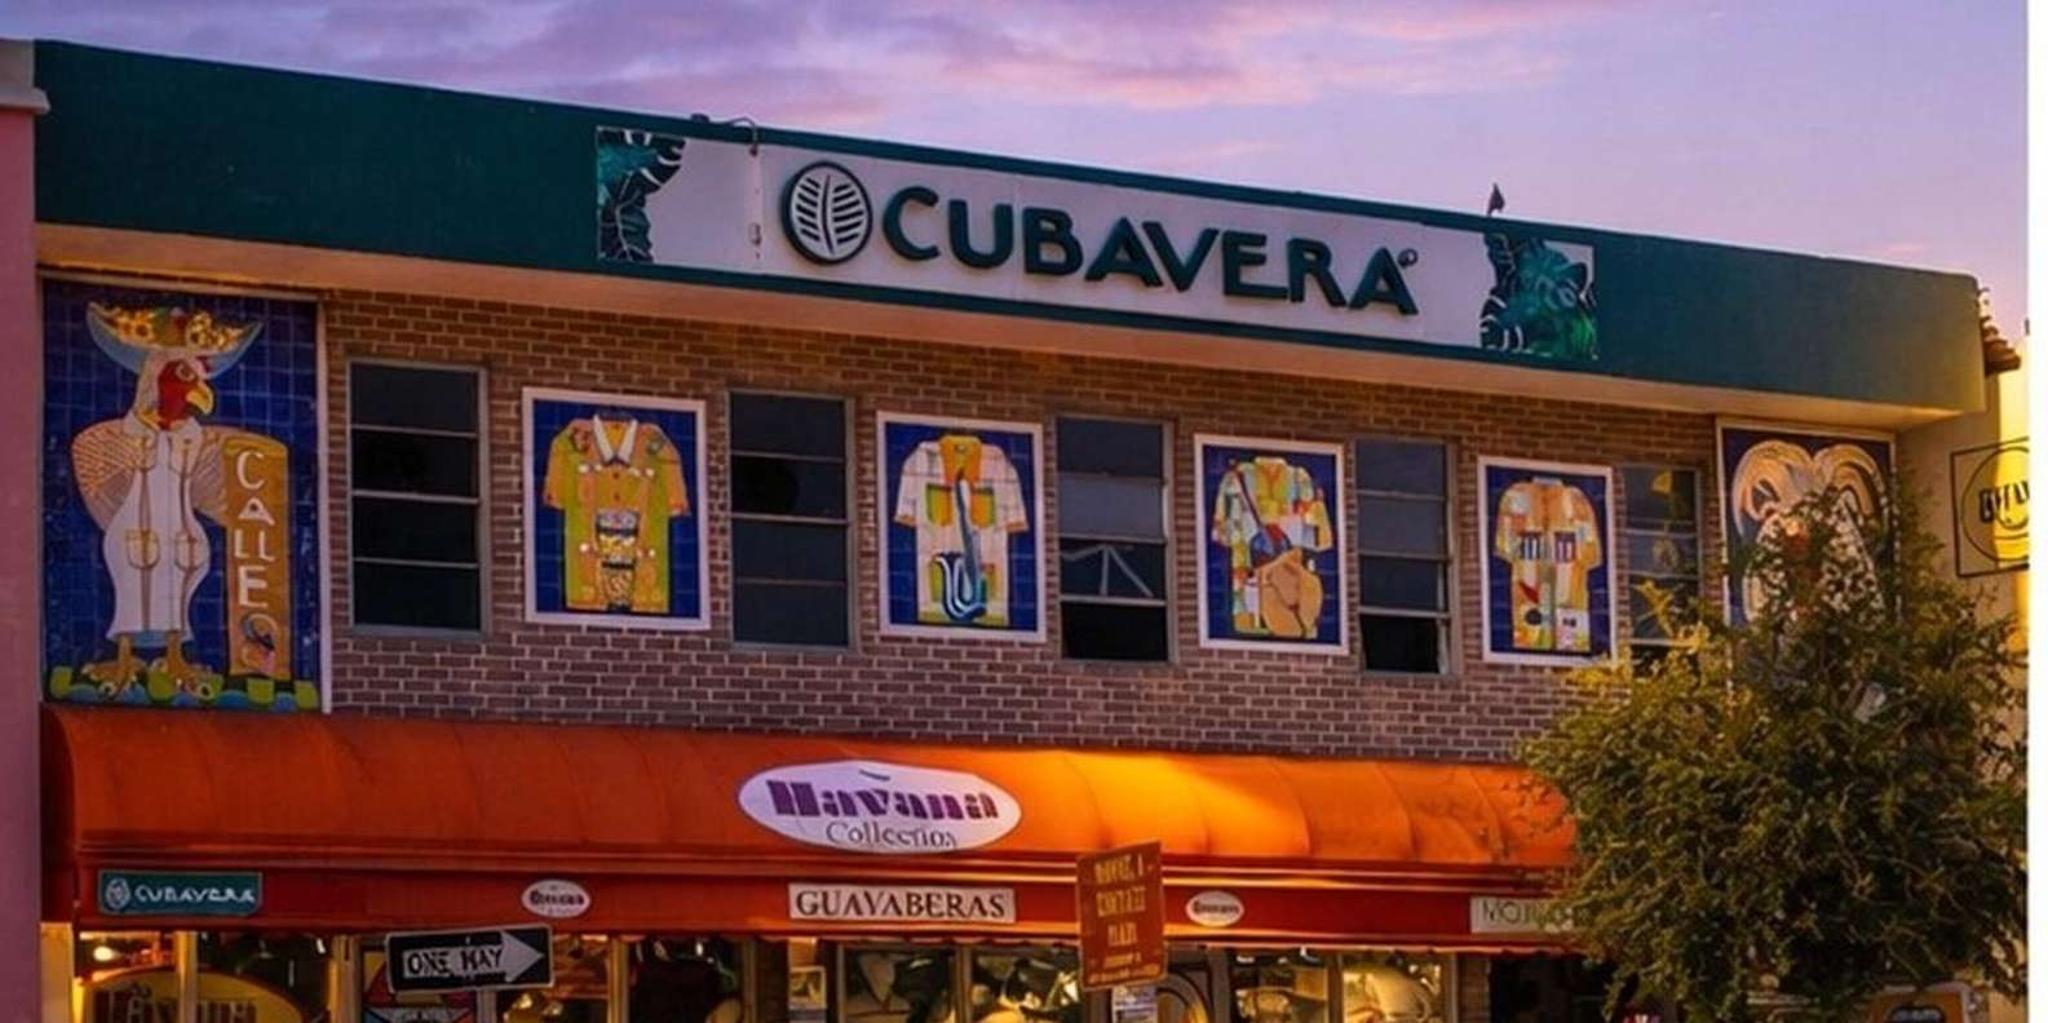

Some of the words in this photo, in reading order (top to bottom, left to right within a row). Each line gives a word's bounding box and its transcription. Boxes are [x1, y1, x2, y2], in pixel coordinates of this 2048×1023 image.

[882, 186, 1418, 315] CUBAVERA
[766, 780, 998, 820] Havana
[826, 820, 957, 849] Collection
[407, 951, 450, 974] ONE
[460, 949, 503, 971] WAY
